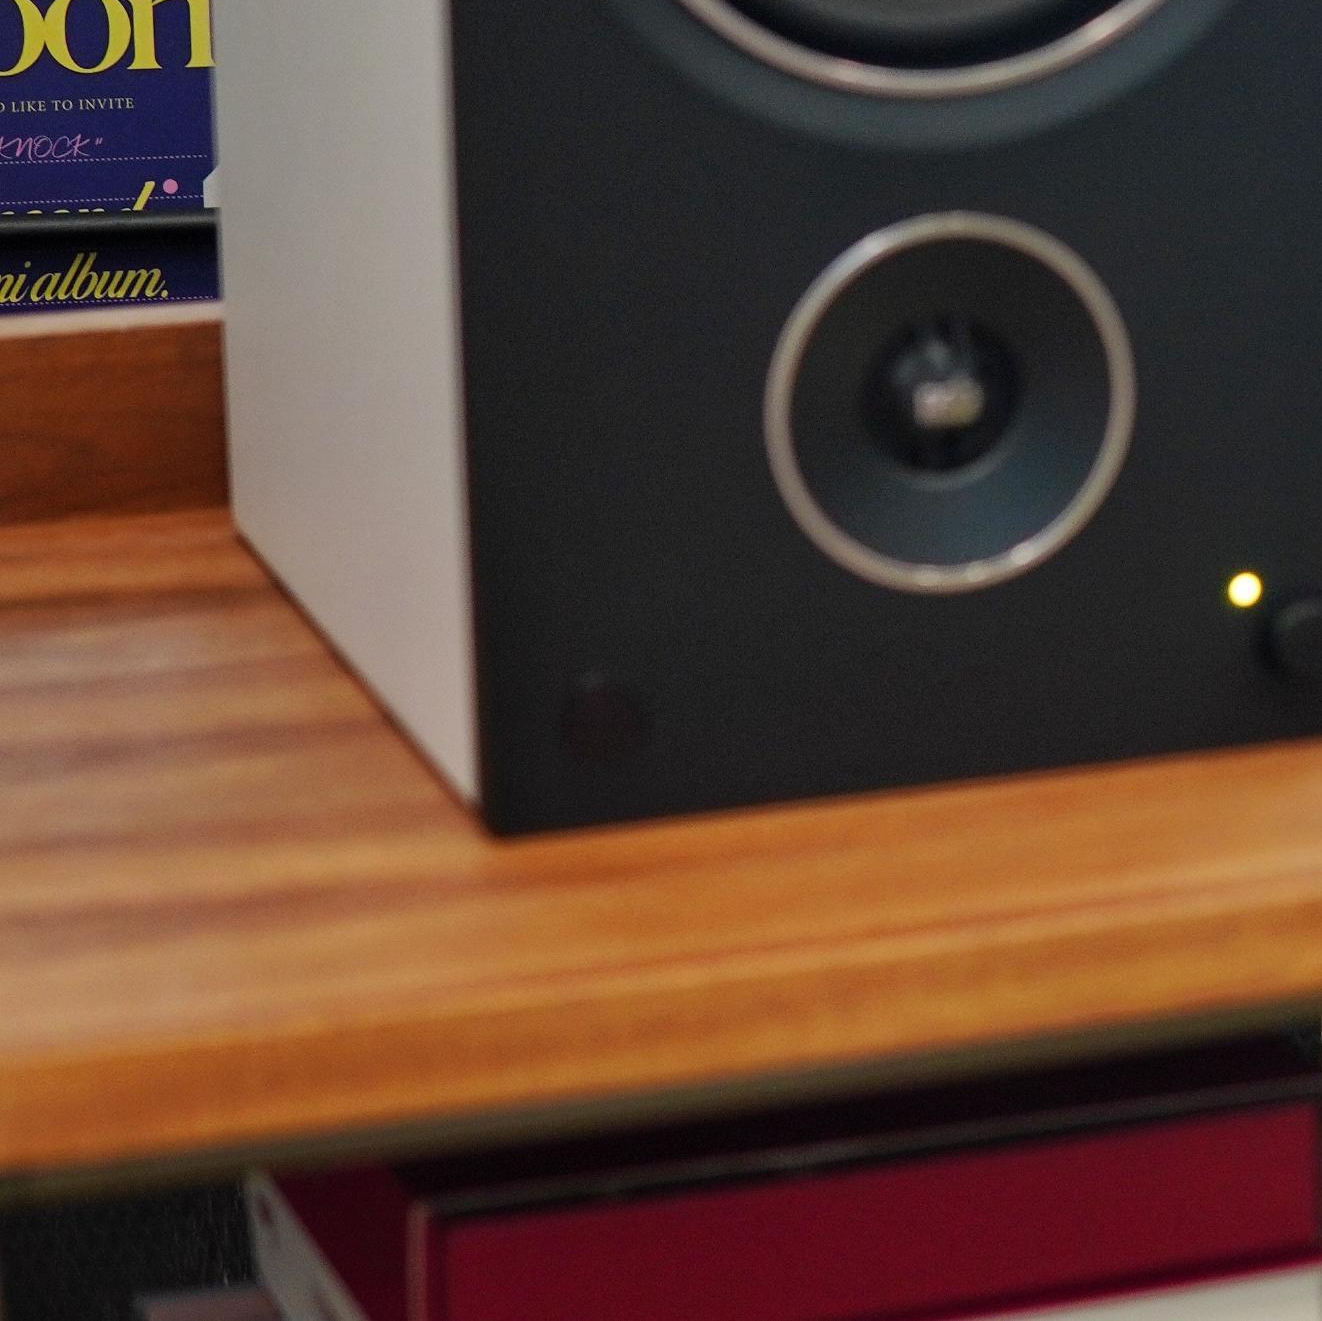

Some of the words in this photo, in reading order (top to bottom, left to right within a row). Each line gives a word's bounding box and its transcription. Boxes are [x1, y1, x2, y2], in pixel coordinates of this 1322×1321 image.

[11, 100, 47, 113] LIKE
[51, 99, 74, 111] TO
[79, 97, 135, 110] INVITE
[30, 252, 169, 303] album.
